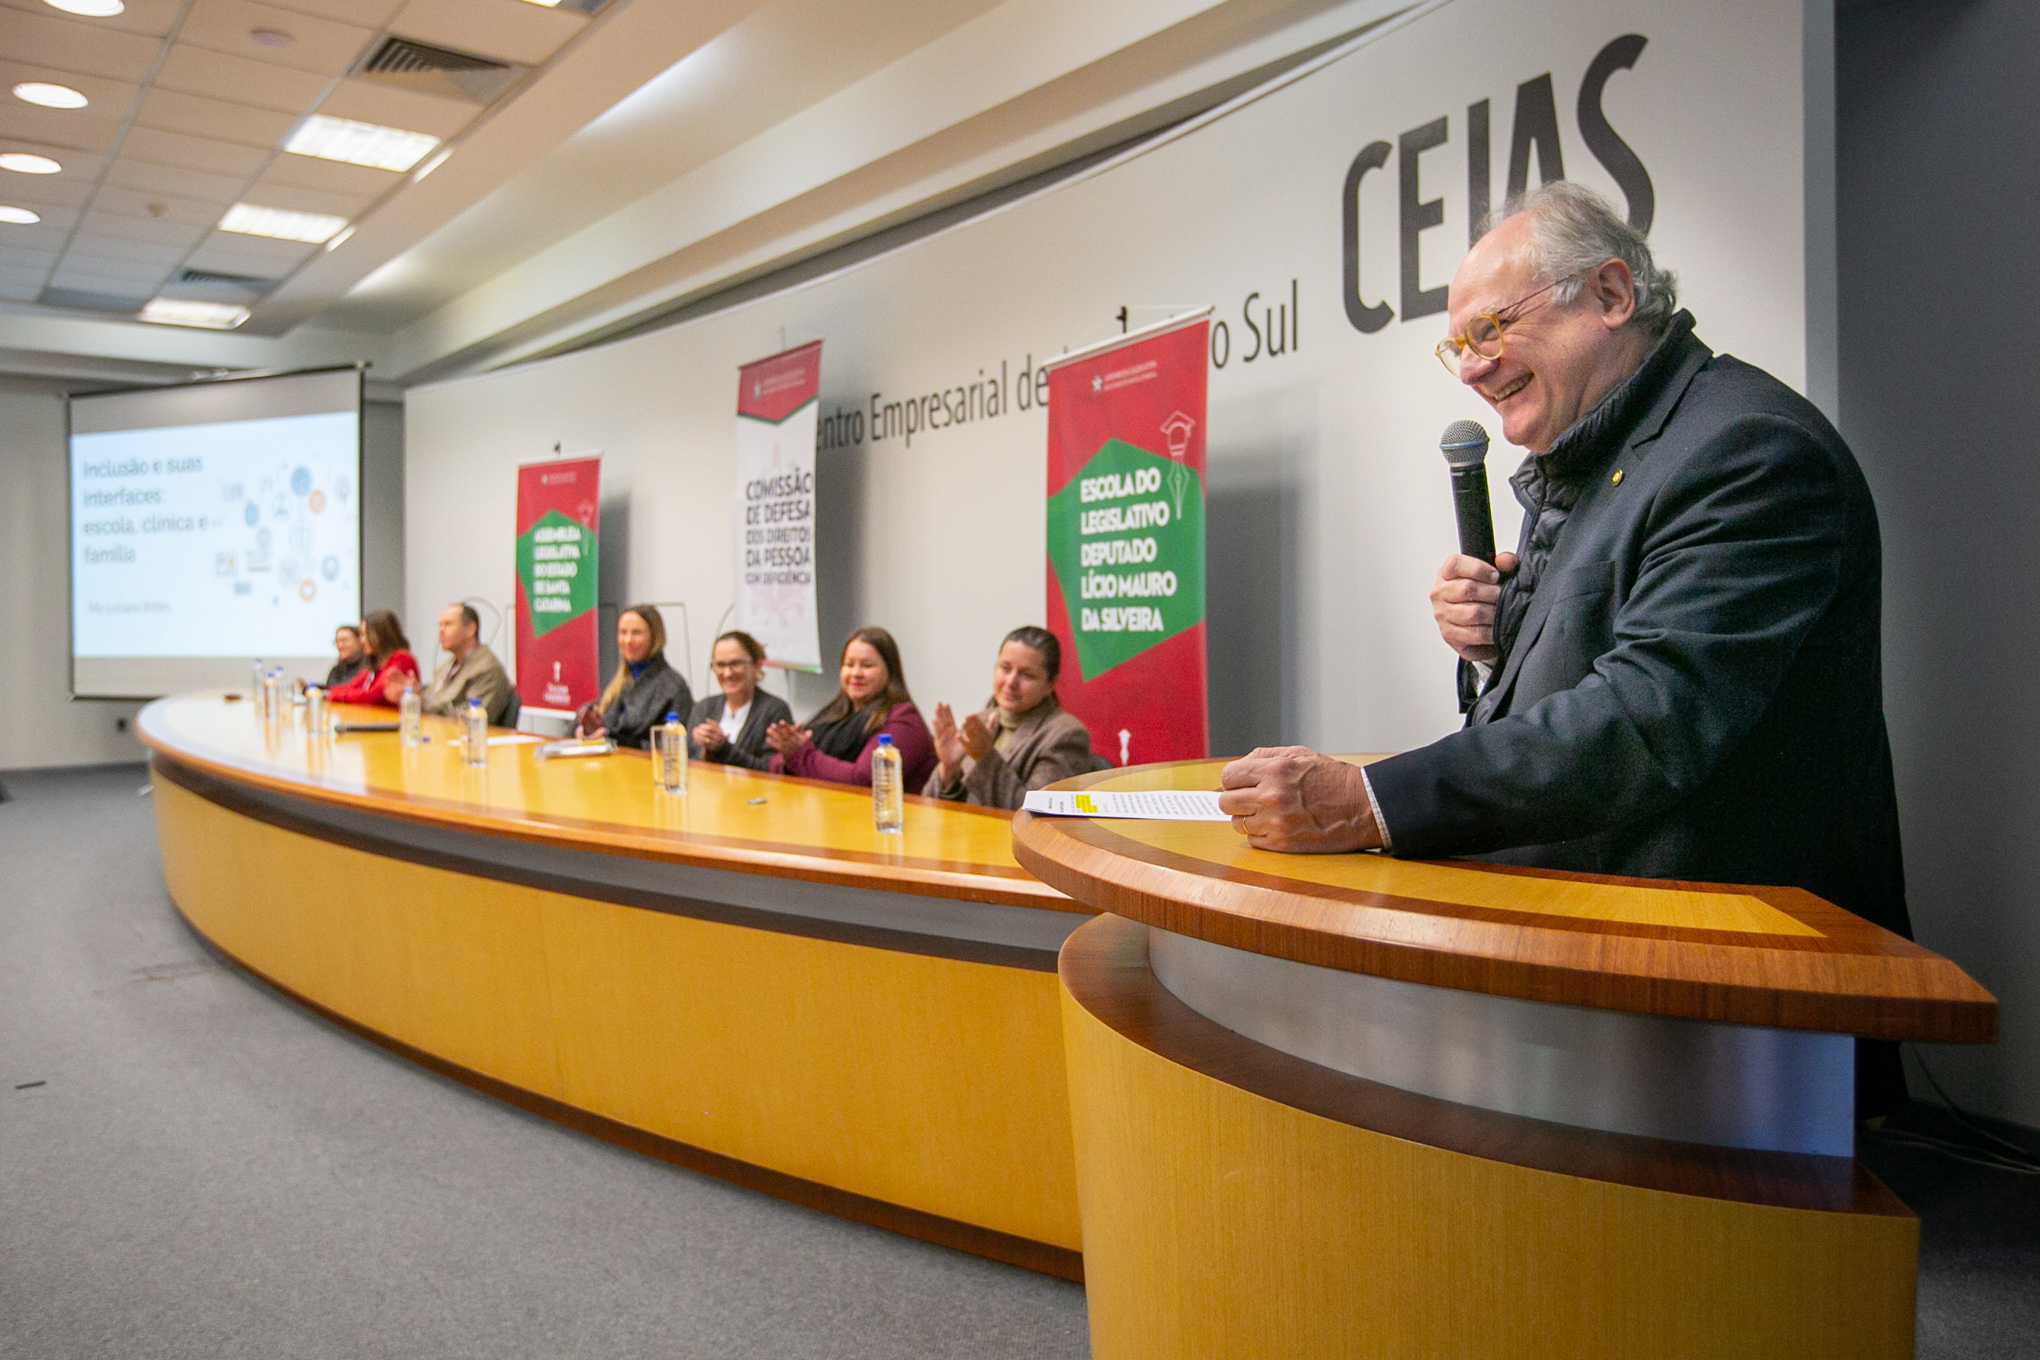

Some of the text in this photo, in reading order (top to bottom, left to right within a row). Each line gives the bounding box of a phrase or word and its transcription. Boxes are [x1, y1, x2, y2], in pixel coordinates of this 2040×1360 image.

[870, 359, 1008, 449] Empresarial
[1016, 353, 1049, 412] de
[1243, 279, 1298, 364] Sul
[152, 458, 162, 474] e
[166, 455, 204, 473] suas
[745, 466, 813, 500] COMISSÃO
[1080, 467, 1161, 503] ESCOLA DO
[198, 514, 209, 531] e
[746, 500, 810, 525] DE DEFESA
[1080, 500, 1170, 535] LEGISLATIVO
[746, 546, 811, 567] DA PESSOA
[1080, 537, 1157, 567] DEPUTADO
[1080, 568, 1177, 599] LÍCIO MAURO
[1081, 606, 1164, 631] DA SILVEIRA
